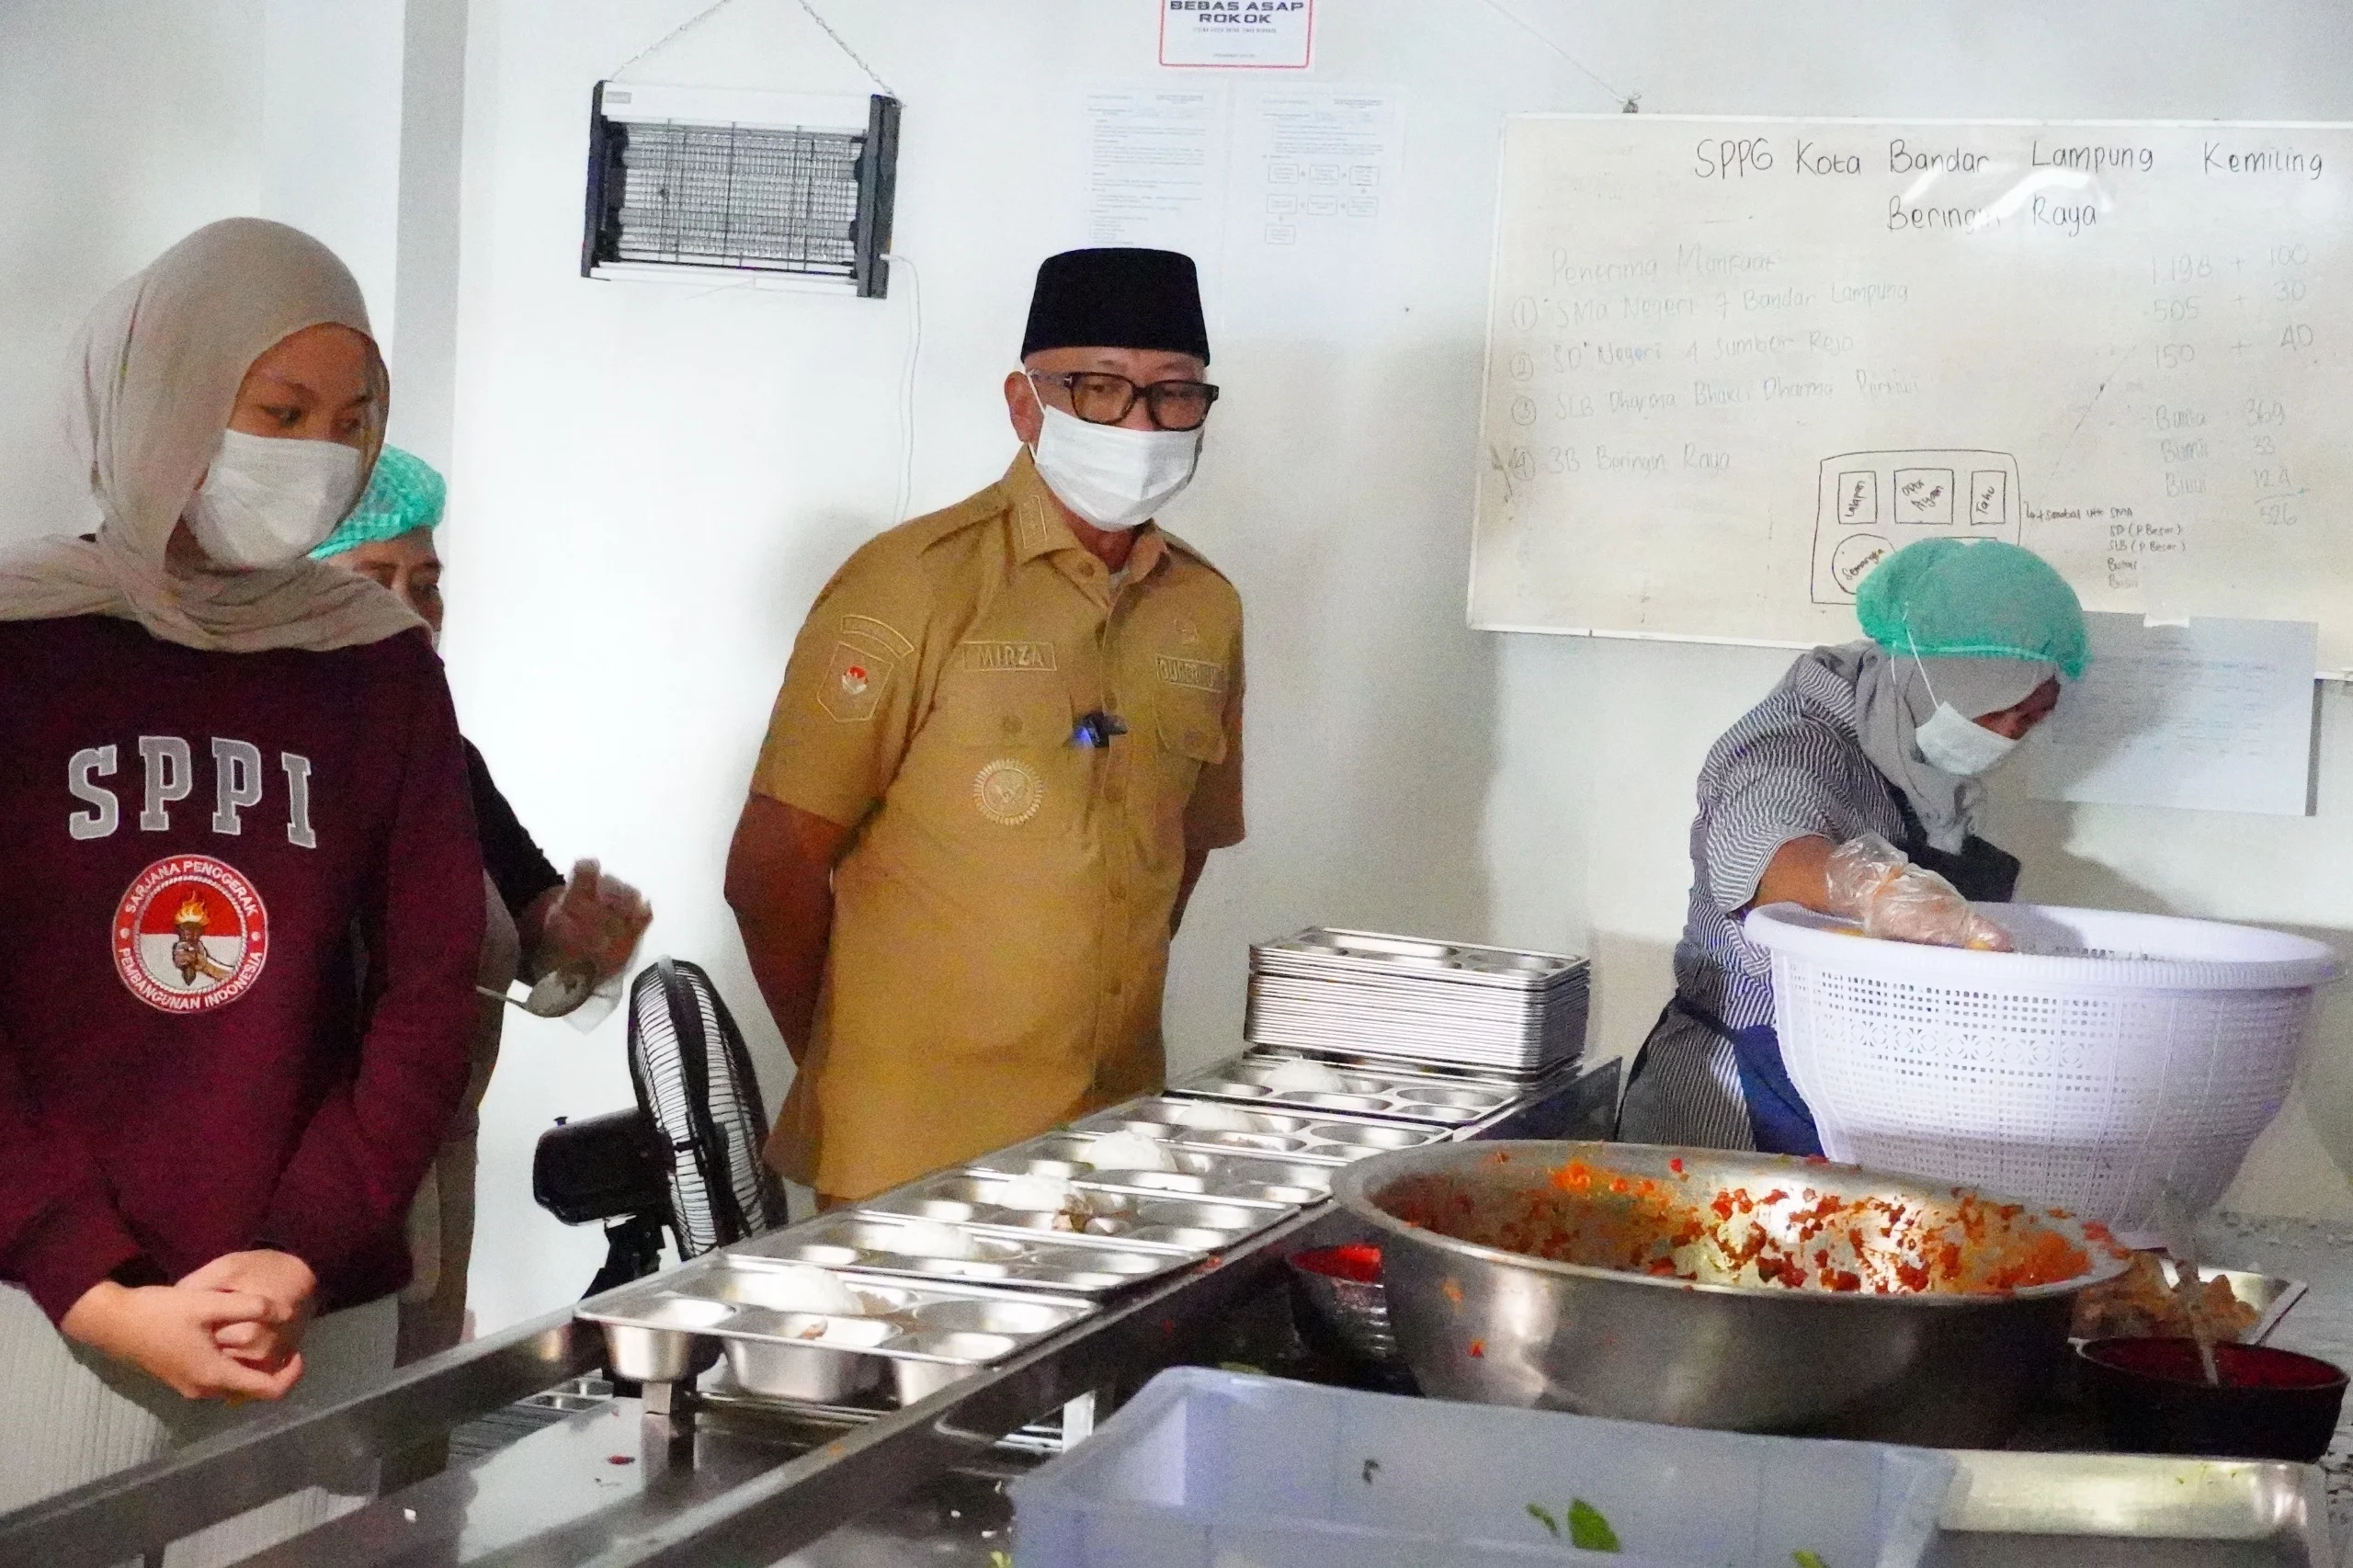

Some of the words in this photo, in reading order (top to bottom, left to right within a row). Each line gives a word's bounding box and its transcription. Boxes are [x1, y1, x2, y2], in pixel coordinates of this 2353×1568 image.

[1170, 1, 1239, 11] BEBAS
[1246, 2, 1304, 11] ASAP
[1199, 14, 1271, 24] ROKOK
[1695, 137, 1774, 180] SPPG
[1796, 138, 1861, 176] Kota
[1889, 138, 1990, 174] Bandar
[2031, 140, 2154, 174] Lampung
[2203, 141, 2325, 181] Kemiling
[2032, 194, 2097, 237] Raya
[2268, 243, 2310, 268] 100
[1624, 295, 1695, 324] Negeri
[1743, 288, 1817, 312] Bandar
[1831, 282, 1909, 306] Lampung
[2273, 278, 2307, 302] 30
[1597, 341, 1663, 367] Negeri
[1808, 330, 1855, 357] Rejo
[2154, 343, 2196, 369] 150
[2279, 323, 2314, 352] 40
[978, 644, 1045, 667] MIRZA
[68, 735, 317, 849] SPPI
[125, 862, 181, 915] SARJANA
[183, 860, 258, 917] PENGGERAK
[119, 947, 202, 1011] PEMBANGUNAN
[204, 950, 264, 1009] INDONESIA
